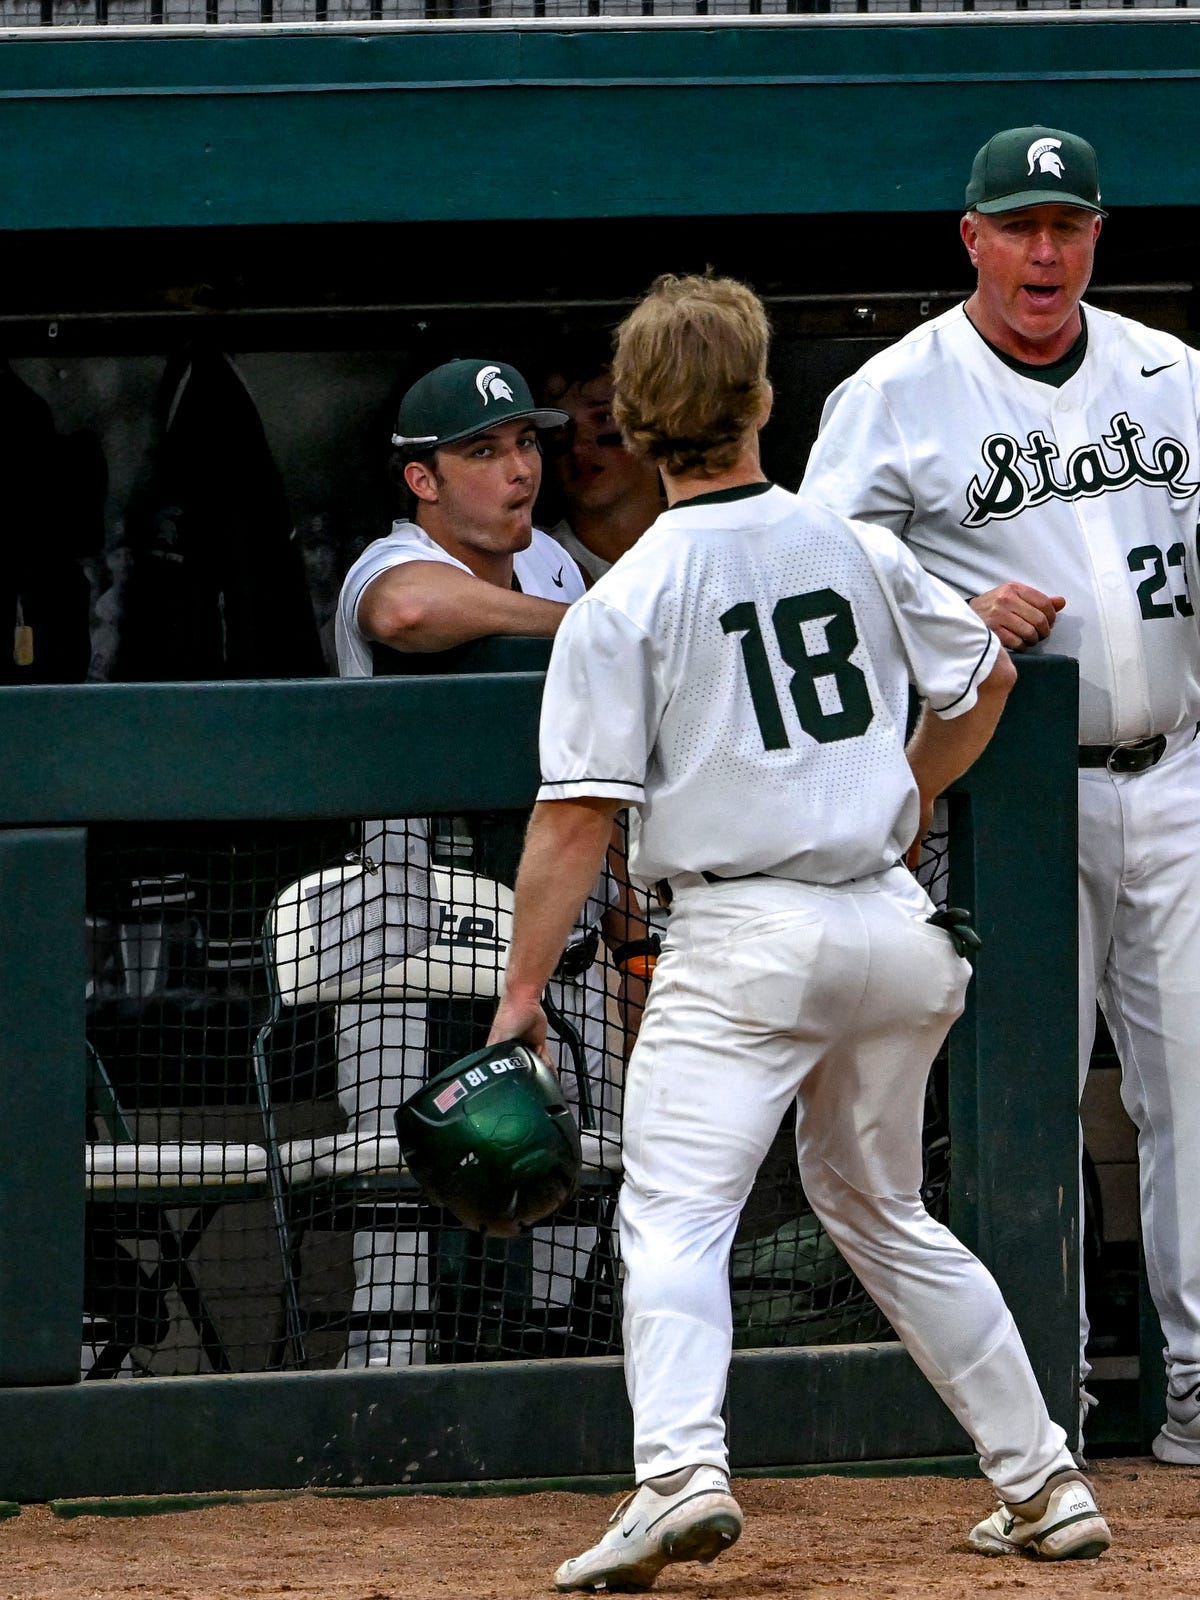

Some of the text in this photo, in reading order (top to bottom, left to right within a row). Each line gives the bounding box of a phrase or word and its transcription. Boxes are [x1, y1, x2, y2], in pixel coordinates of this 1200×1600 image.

[960, 411, 1200, 527] State
[718, 588, 875, 751] 18
[465, 1067, 488, 1087] 18
